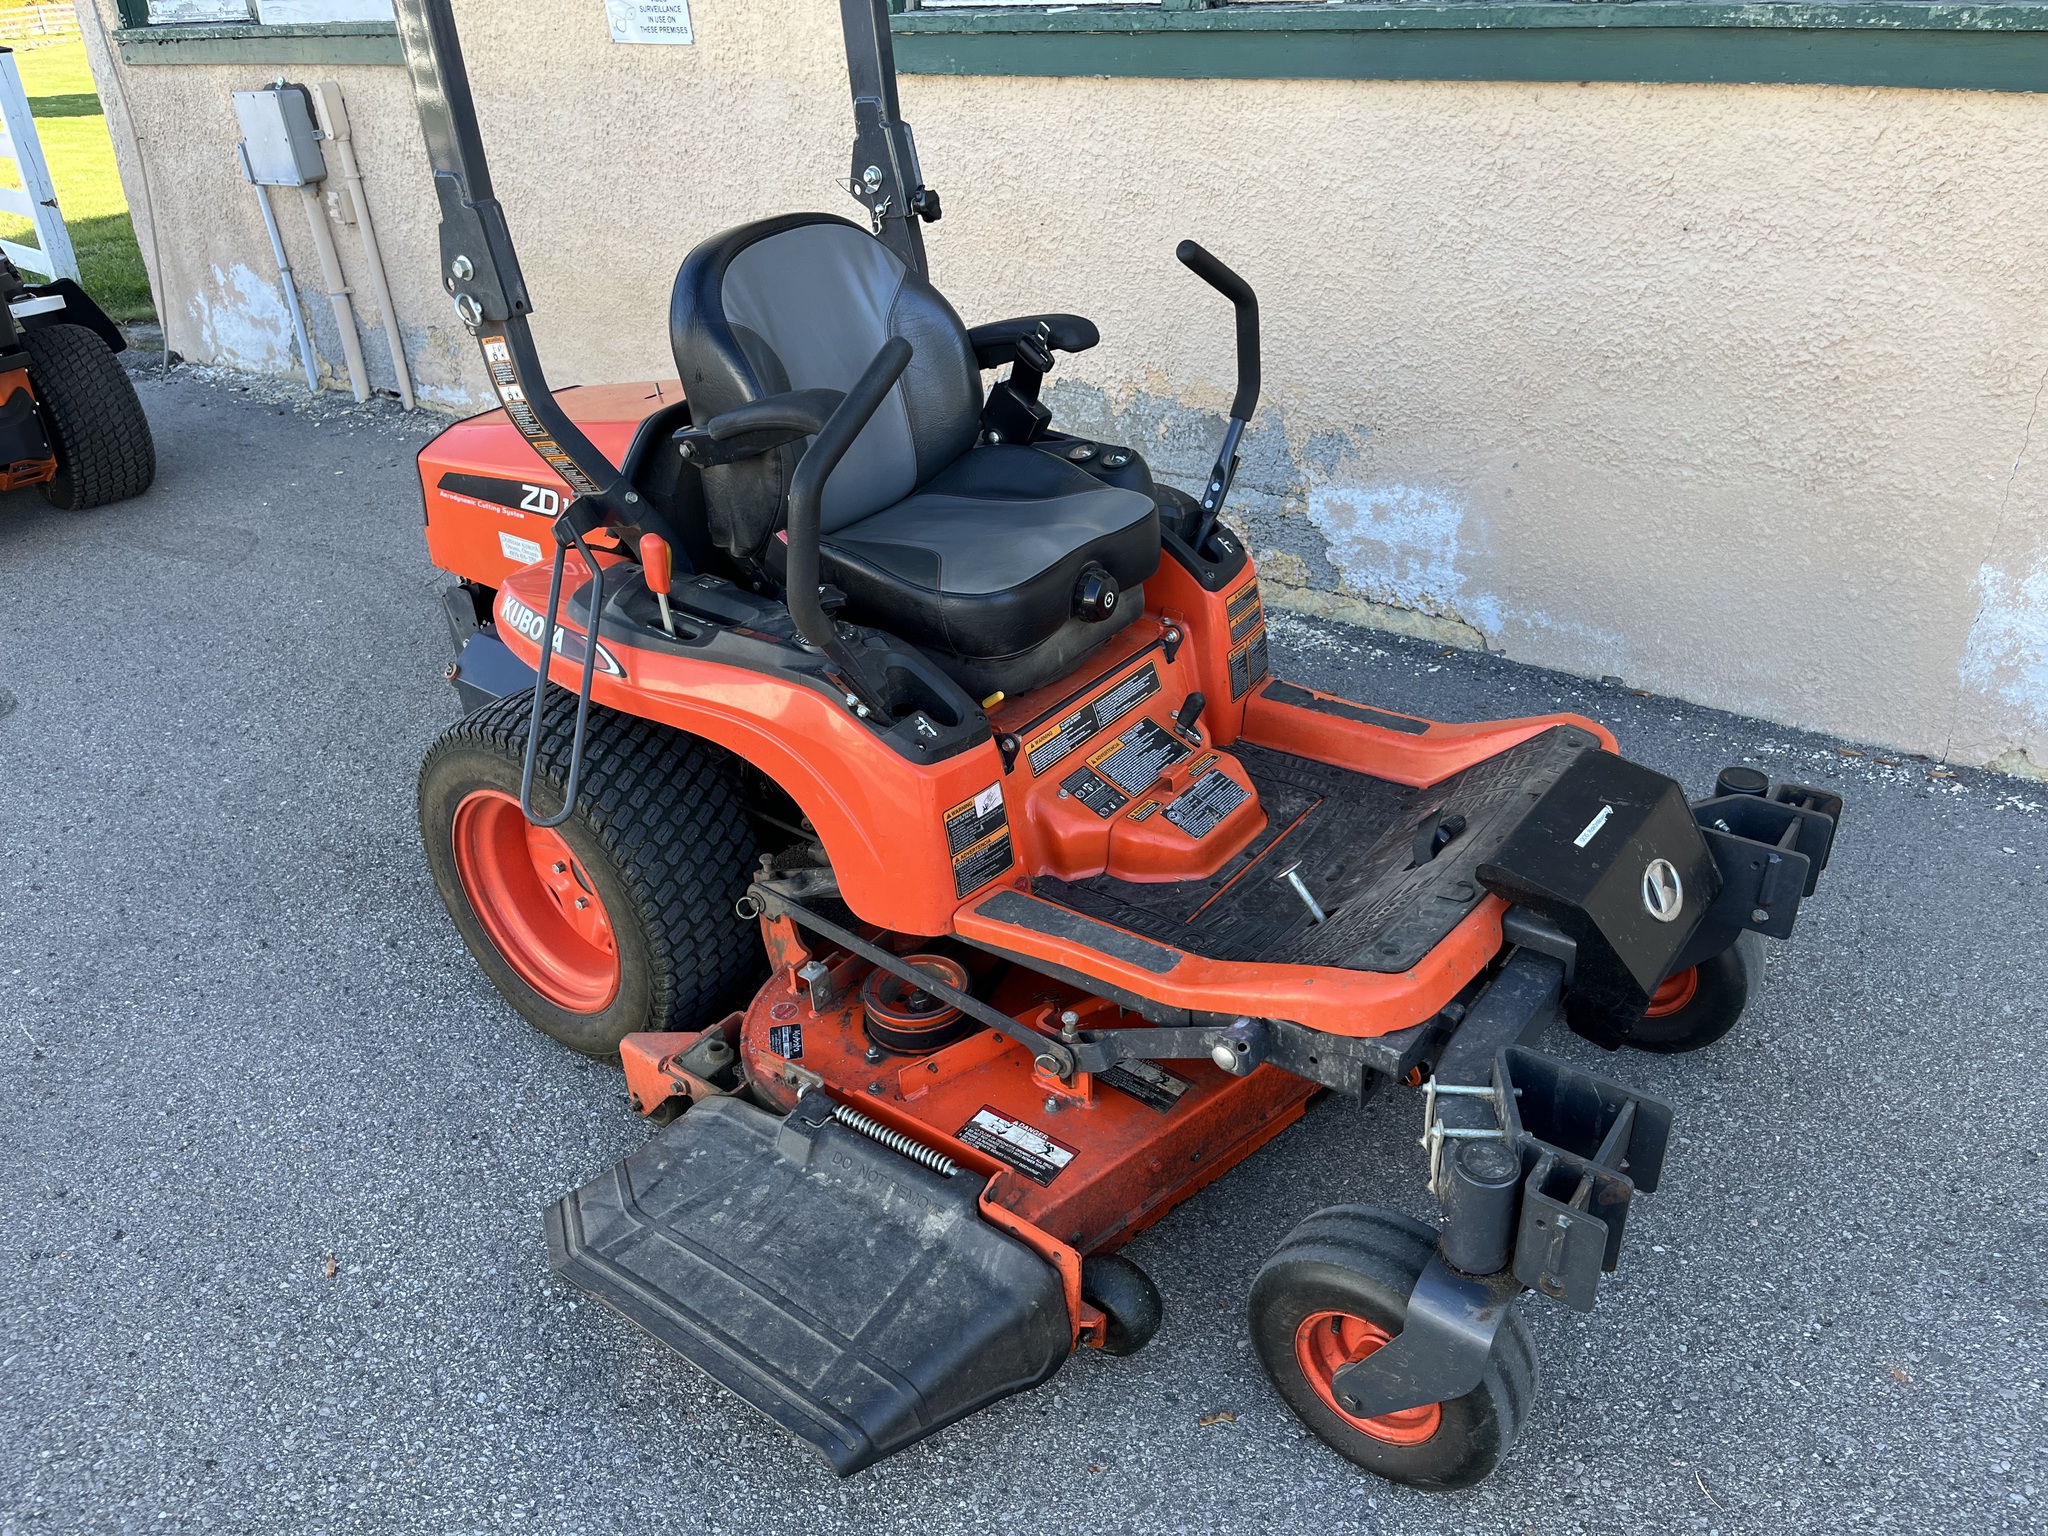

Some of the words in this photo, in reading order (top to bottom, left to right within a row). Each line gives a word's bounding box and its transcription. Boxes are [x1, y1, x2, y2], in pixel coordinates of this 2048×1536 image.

[639, 5, 681, 13] SURVEILLANCE
[659, 26, 688, 34] PREMISES
[440, 490, 476, 506] Aerodynamic
[477, 500, 501, 513] Cutting
[502, 507, 525, 519] System
[501, 595, 564, 653] KUBOA
[951, 800, 973, 816] WARNING
[960, 837, 992, 860] ADVERTENCIA
[1017, 1122, 1050, 1140] DANGER
[831, 1151, 853, 1170] DO
[858, 1164, 887, 1184] NOT
[890, 1180, 946, 1219] REMOVE
